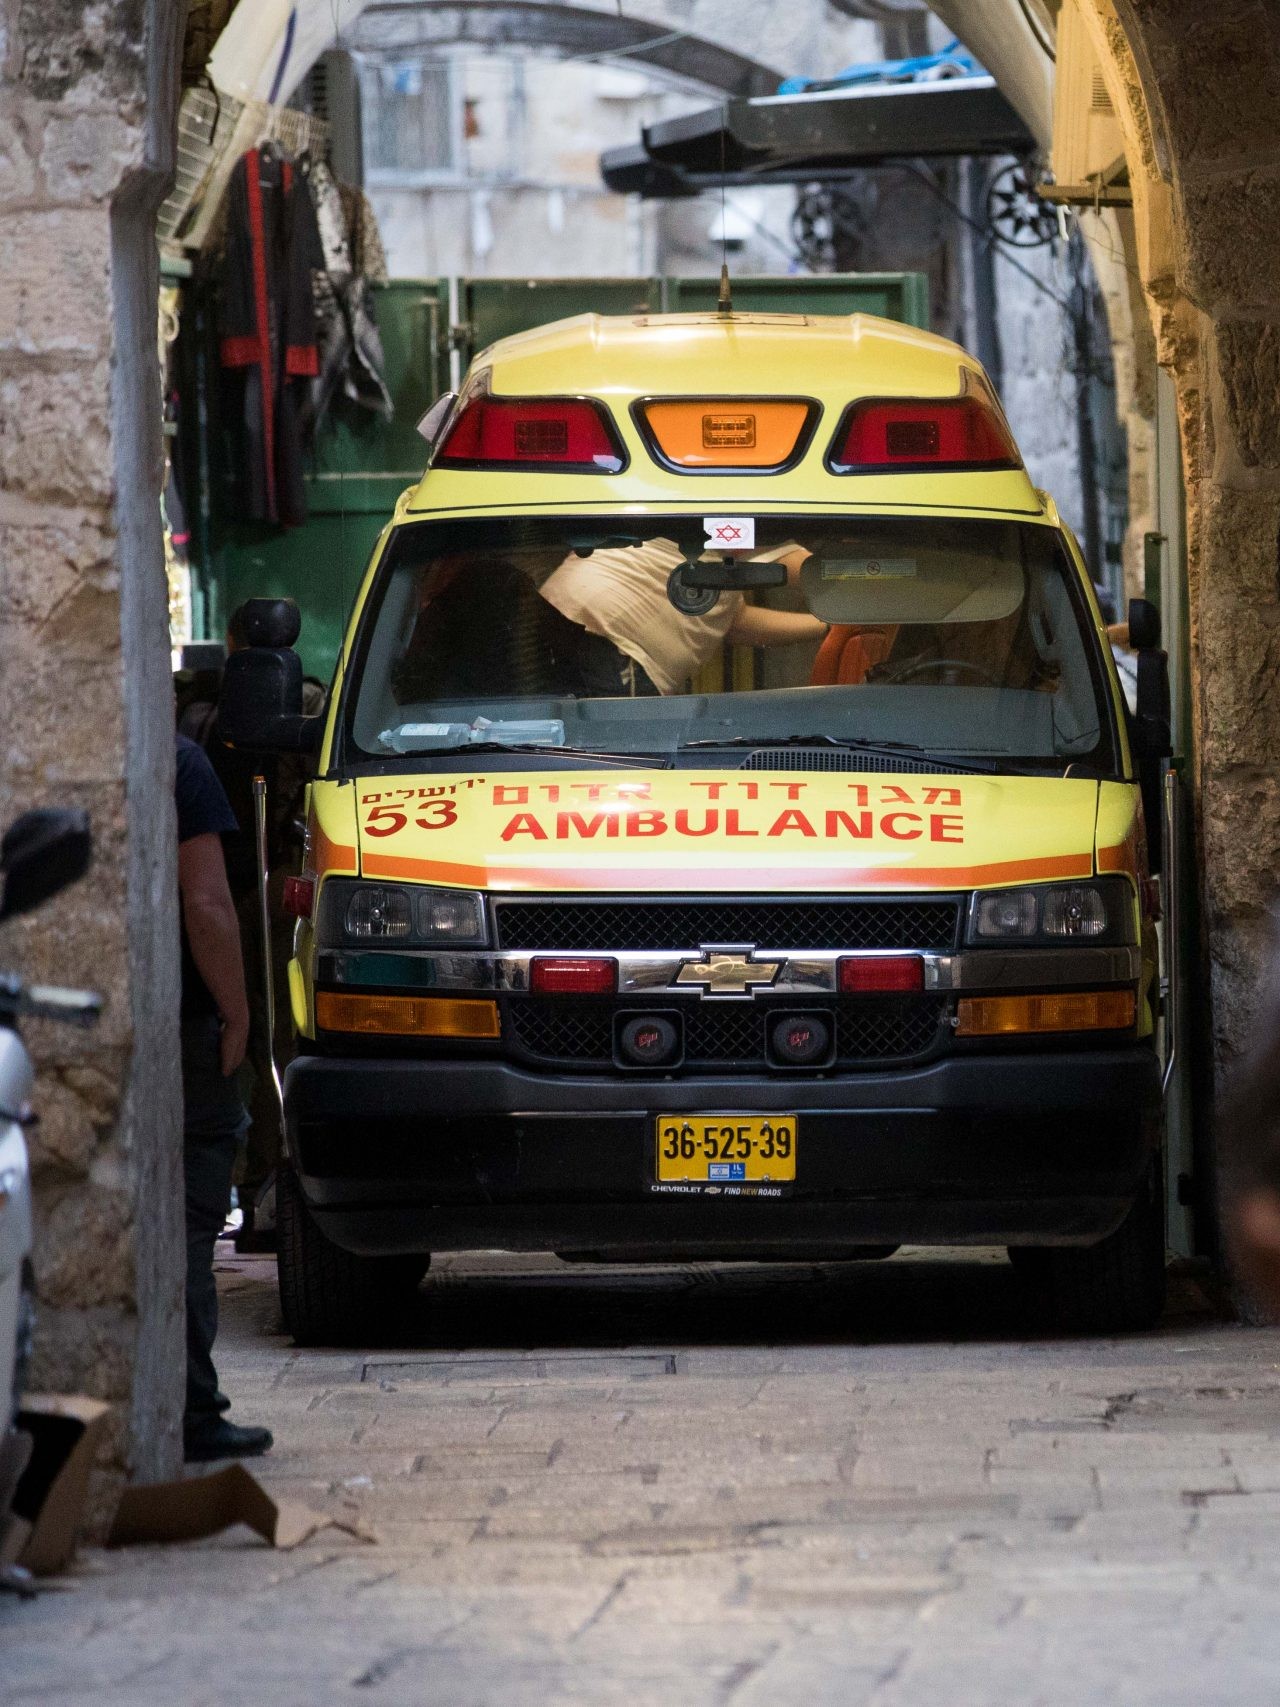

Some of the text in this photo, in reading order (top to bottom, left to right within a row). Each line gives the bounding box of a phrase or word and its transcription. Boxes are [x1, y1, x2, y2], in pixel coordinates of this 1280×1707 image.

[362, 778, 485, 804] ירושלים
[493, 782, 962, 806] מגן דוד אדום
[364, 800, 458, 837] 53
[500, 809, 964, 843] AMBULANCE
[663, 1127, 791, 1159] 36-525-39
[651, 1185, 701, 1194] CHEVROLET
